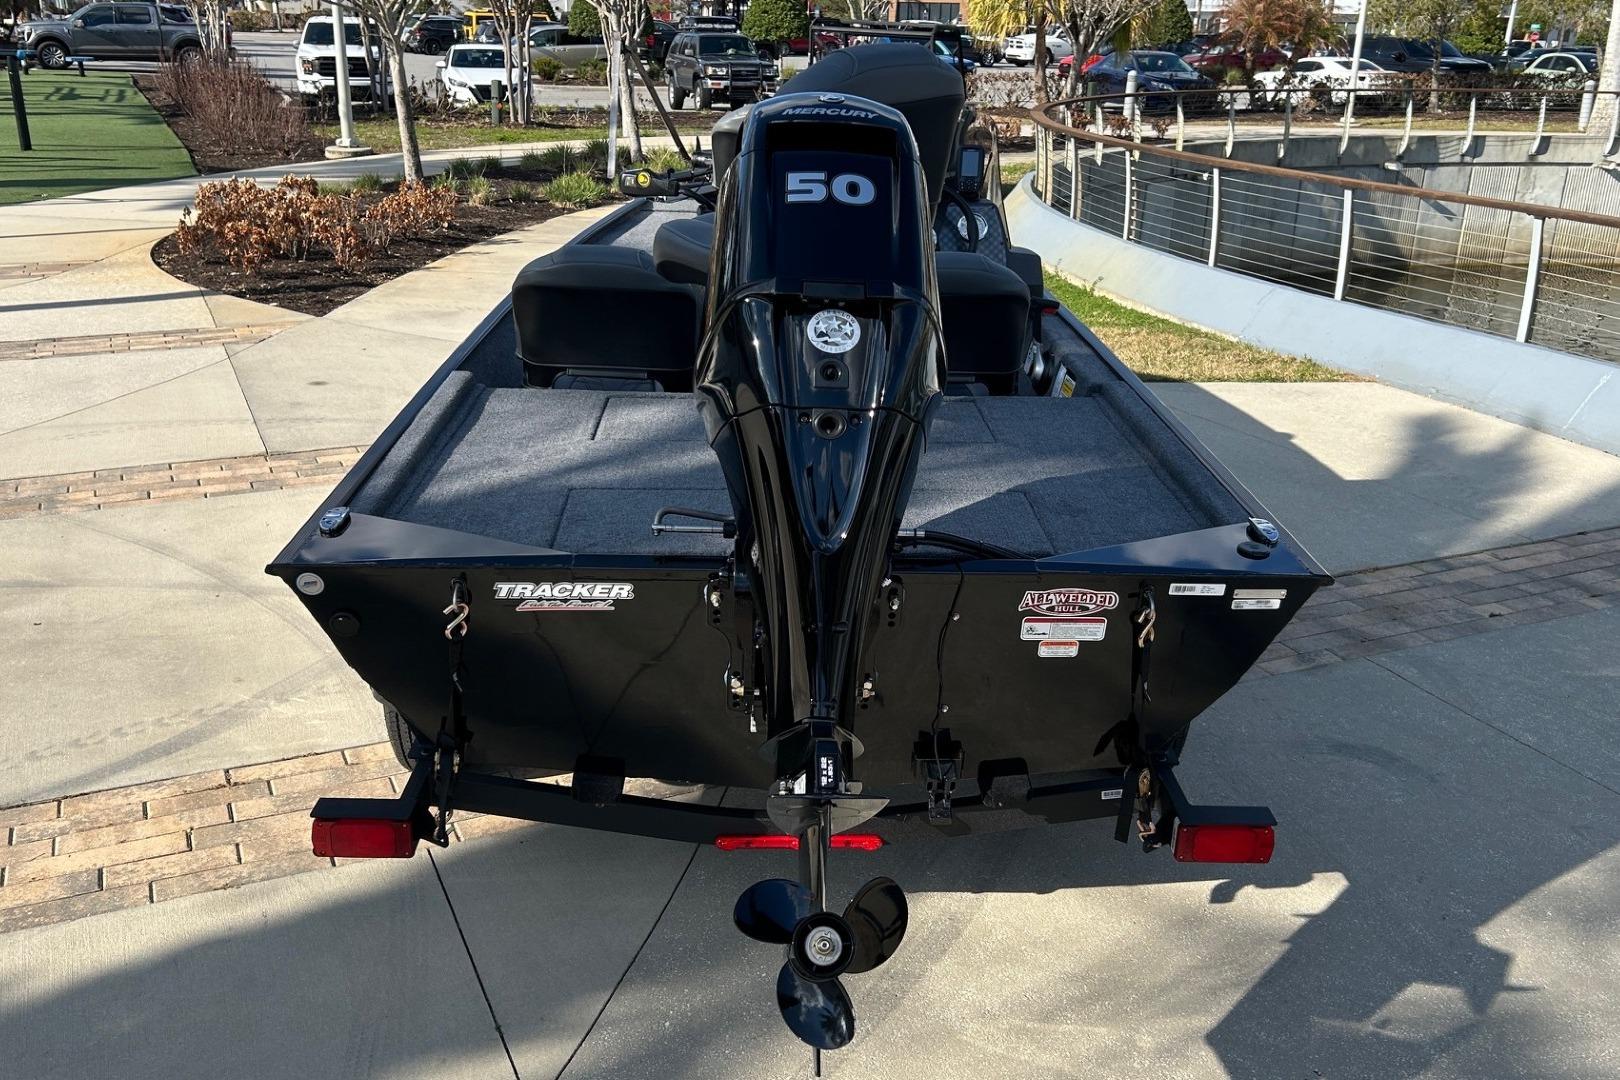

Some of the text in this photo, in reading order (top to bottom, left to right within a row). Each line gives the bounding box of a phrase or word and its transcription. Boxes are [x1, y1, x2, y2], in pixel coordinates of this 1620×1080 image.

[783, 107, 879, 119] MERCURY
[785, 171, 877, 206] 50
[494, 583, 633, 599] TRACKER
[1022, 593, 1117, 607] ALL WELDED
